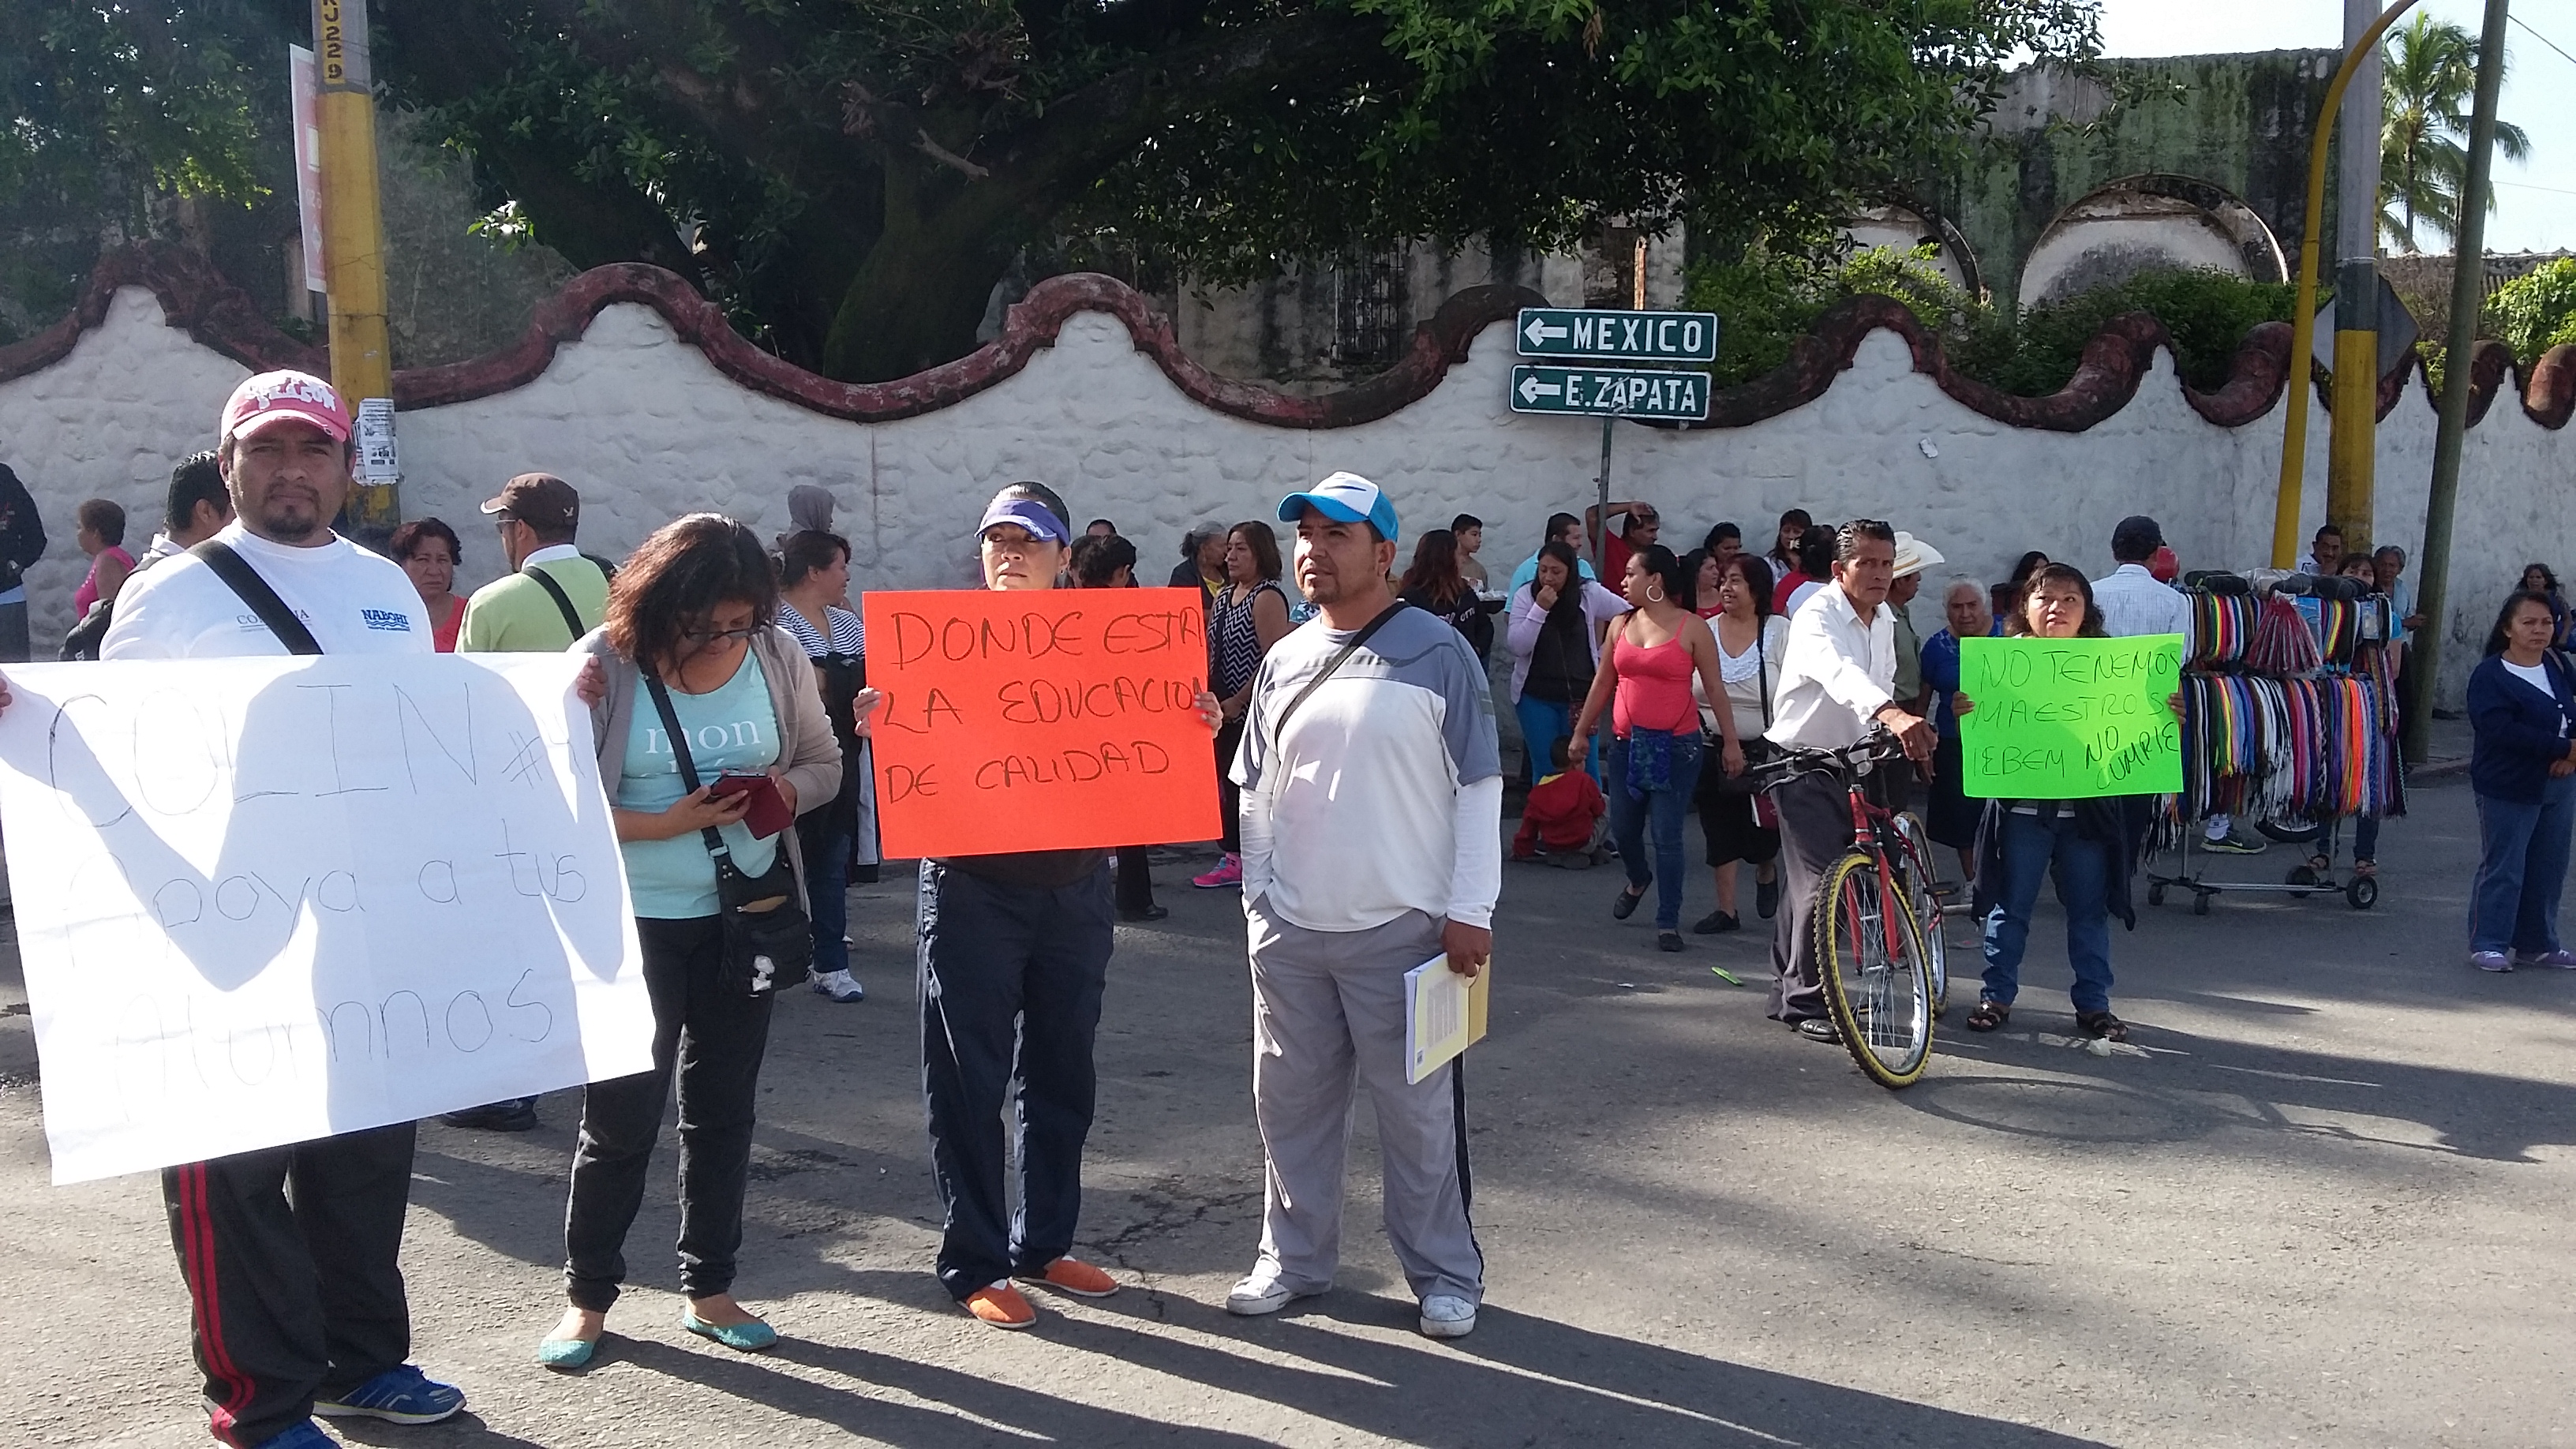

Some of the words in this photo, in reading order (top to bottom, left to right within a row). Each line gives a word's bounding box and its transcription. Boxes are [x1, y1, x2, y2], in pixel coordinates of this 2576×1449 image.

[1573, 316, 1702, 353] MEXICO
[1566, 375, 1697, 412] E.ZAPATA
[890, 612, 1083, 670] DONDE
[1103, 607, 1204, 653] ESTA
[1980, 650, 2031, 693] NO
[2042, 650, 2180, 684] TENEMOS
[883, 688, 963, 733] LA
[1972, 692, 2165, 730] MAESTROS
[49, 682, 477, 829] COLIN
[2086, 725, 2119, 770] NO
[885, 764, 938, 804] DE
[975, 741, 1170, 789] CALIDAD
[417, 859, 462, 905] a
[494, 818, 587, 904] tus
